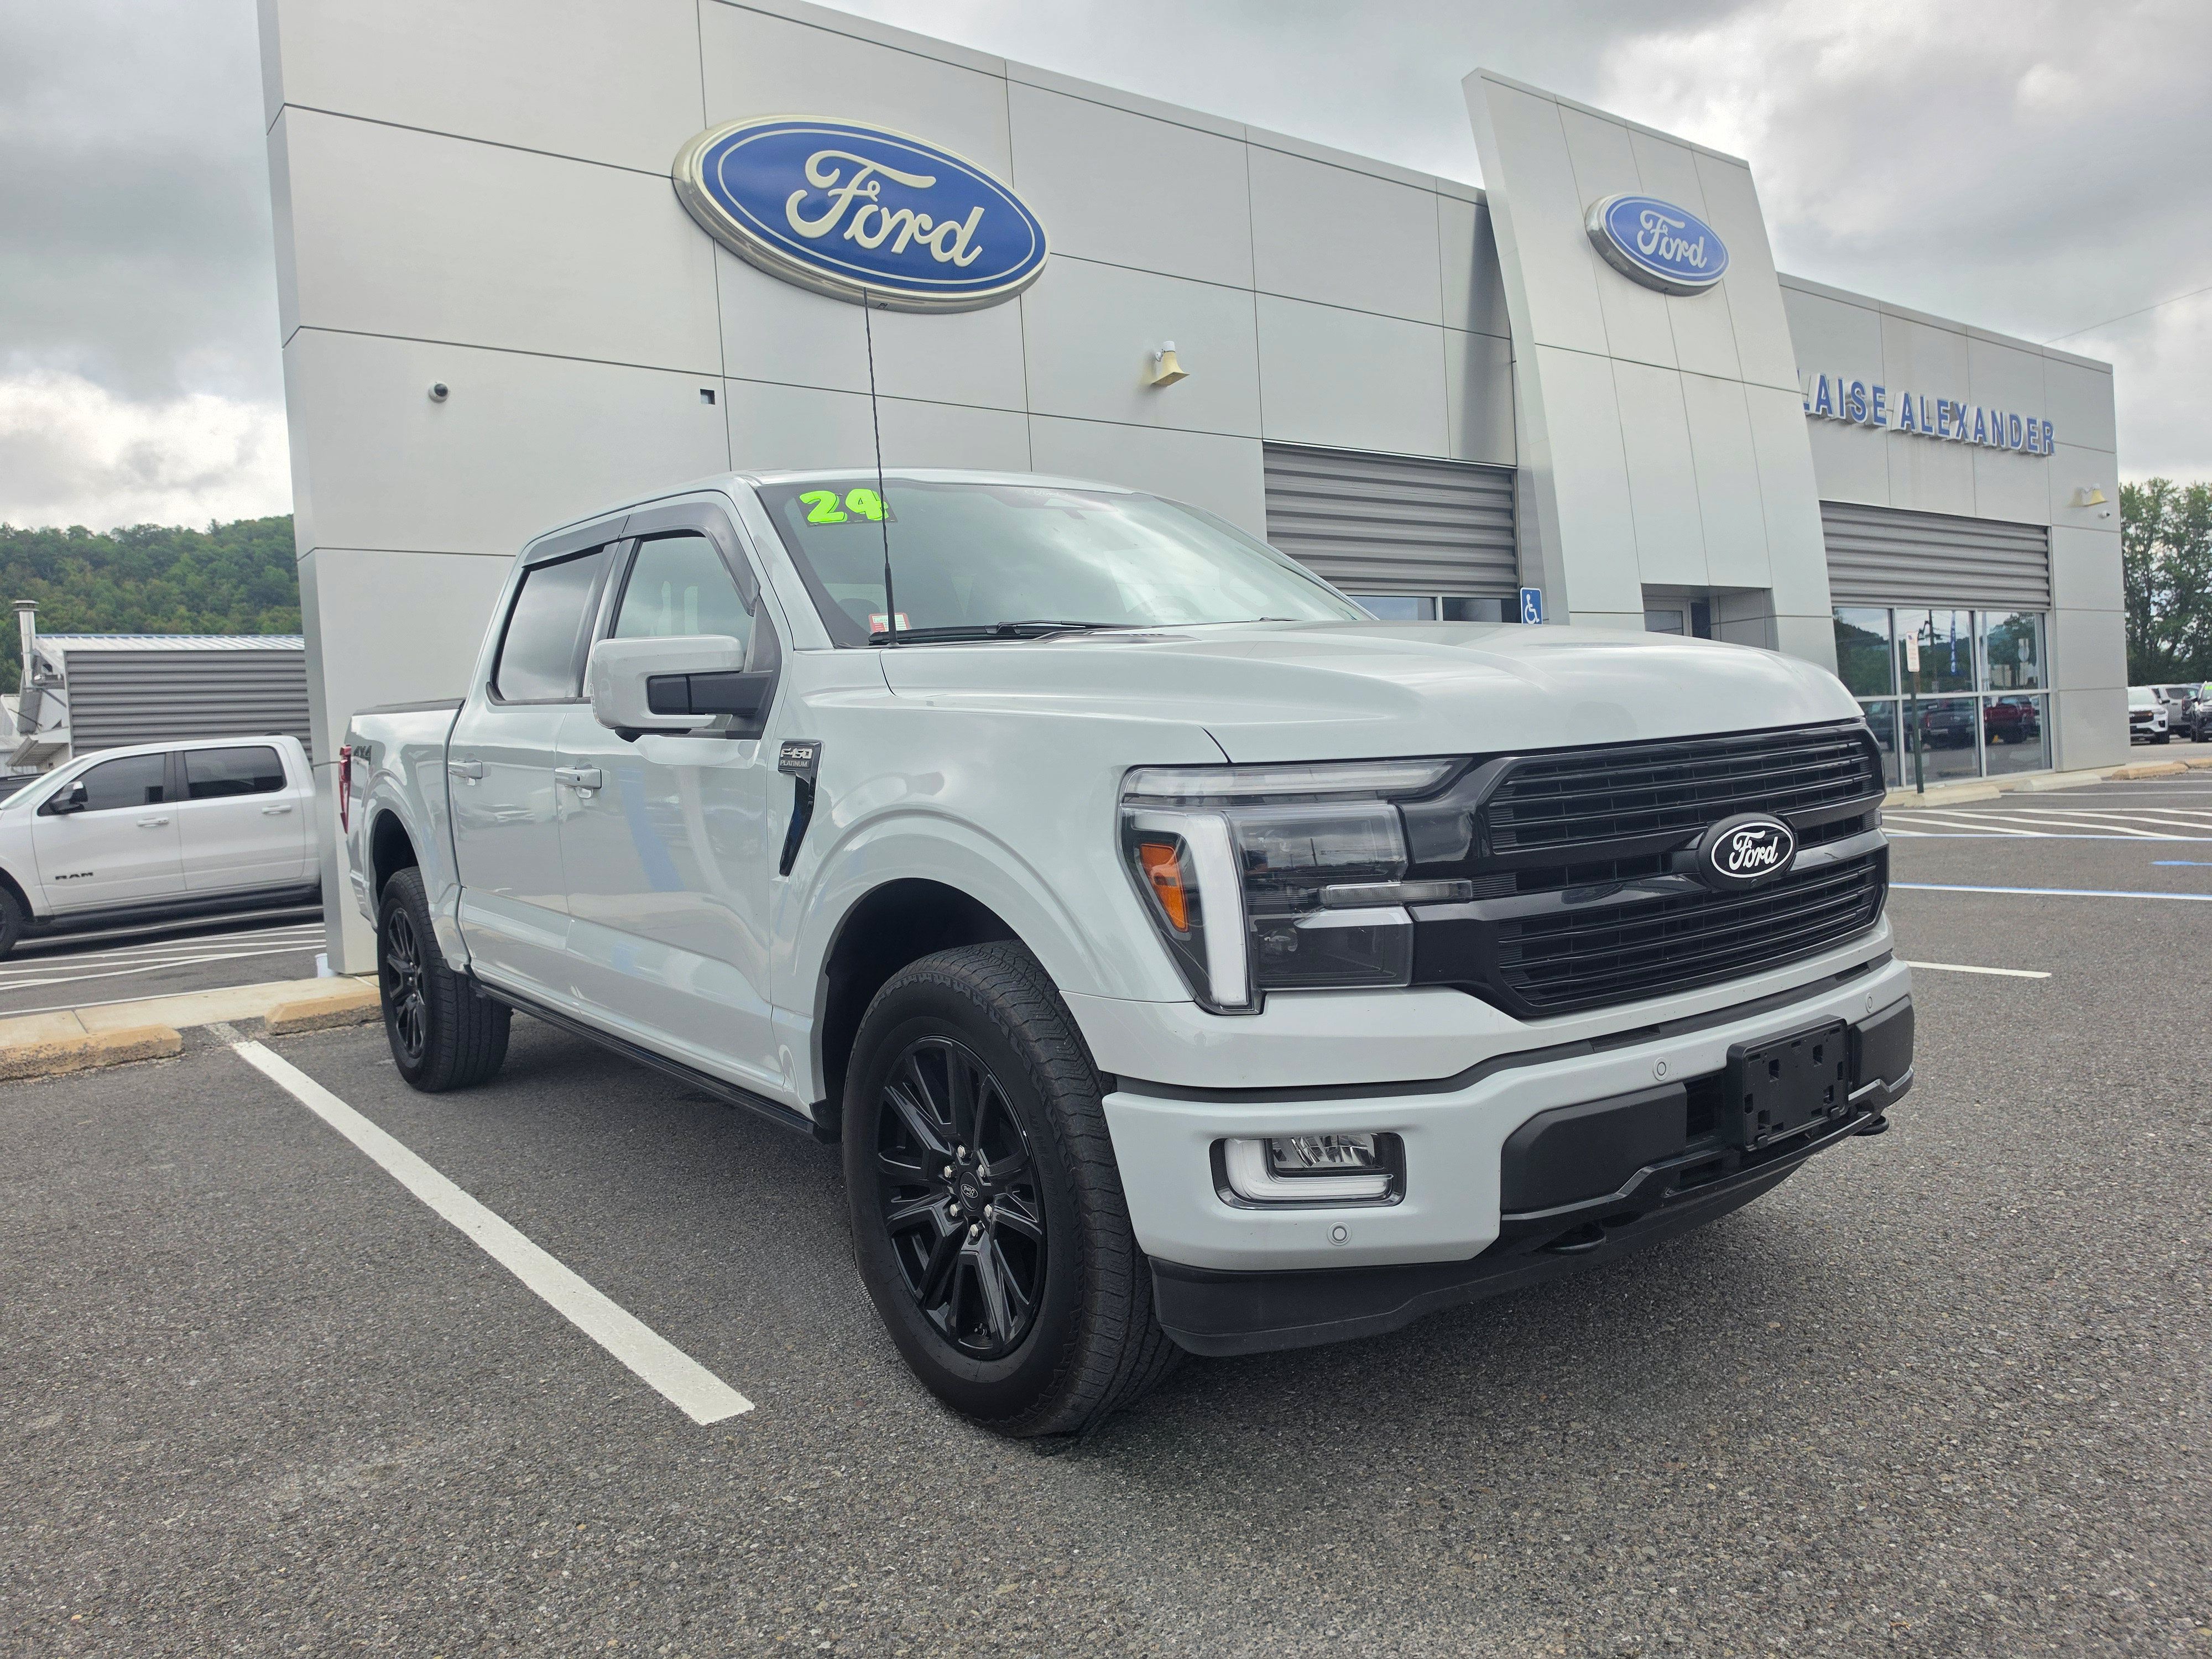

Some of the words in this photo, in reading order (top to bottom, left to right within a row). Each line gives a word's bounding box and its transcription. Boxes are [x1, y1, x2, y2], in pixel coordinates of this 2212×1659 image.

[785, 149, 984, 268] Ford
[1637, 209, 1707, 269] Ford
[1899, 390, 2056, 455] ALEXANDER
[799, 488, 889, 524] 24
[780, 747, 813, 759] F-150
[1729, 830, 1778, 870] Ford
[55, 872, 93, 880] RAM
[963, 1185, 975, 1197] Ford
